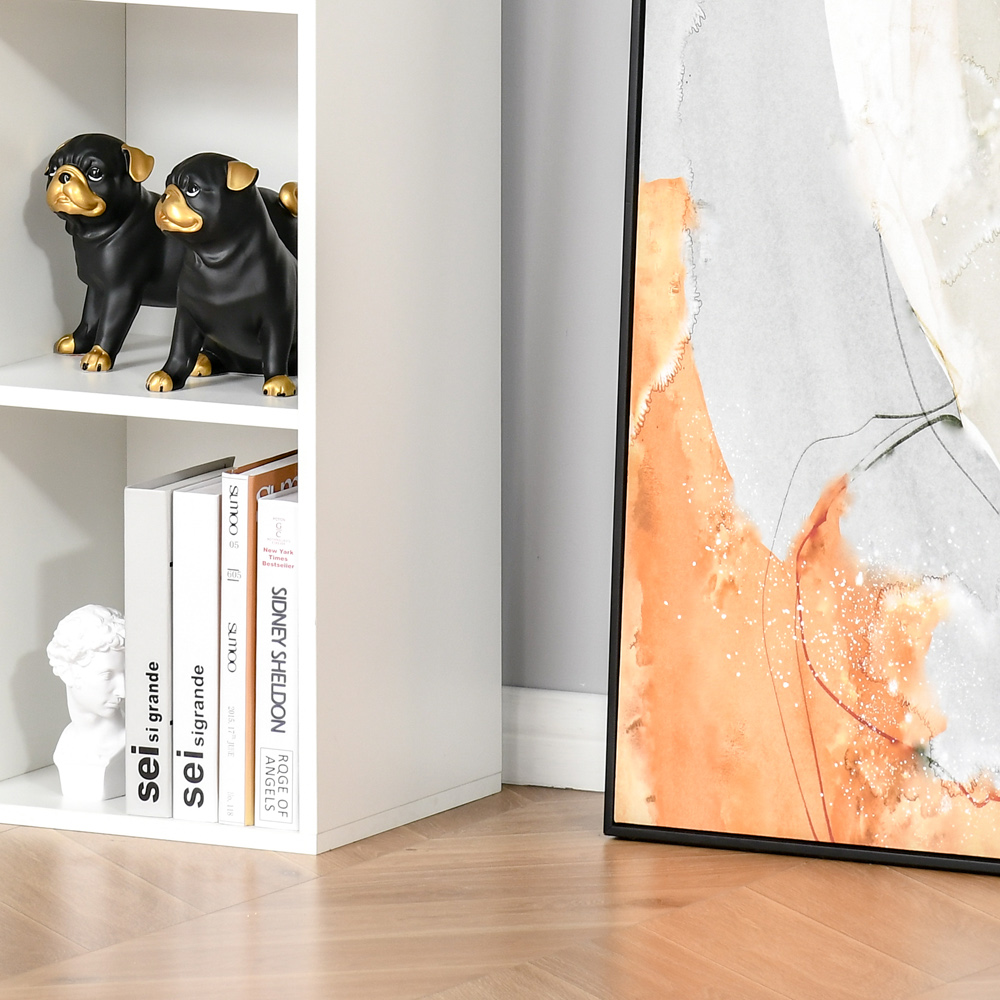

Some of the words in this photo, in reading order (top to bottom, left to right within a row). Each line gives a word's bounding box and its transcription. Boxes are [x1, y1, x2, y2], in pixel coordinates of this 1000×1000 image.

[229, 541, 240, 549] 05
[262, 561, 295, 569] Bestseller
[271, 586, 287, 648] SIDNEY
[270, 650, 287, 733] SHELDON
[130, 745, 160, 803] sei
[145, 661, 163, 722] grande
[176, 750, 205, 808] sei
[264, 755, 276, 811] ANGELS
[277, 799, 289, 818] OF
